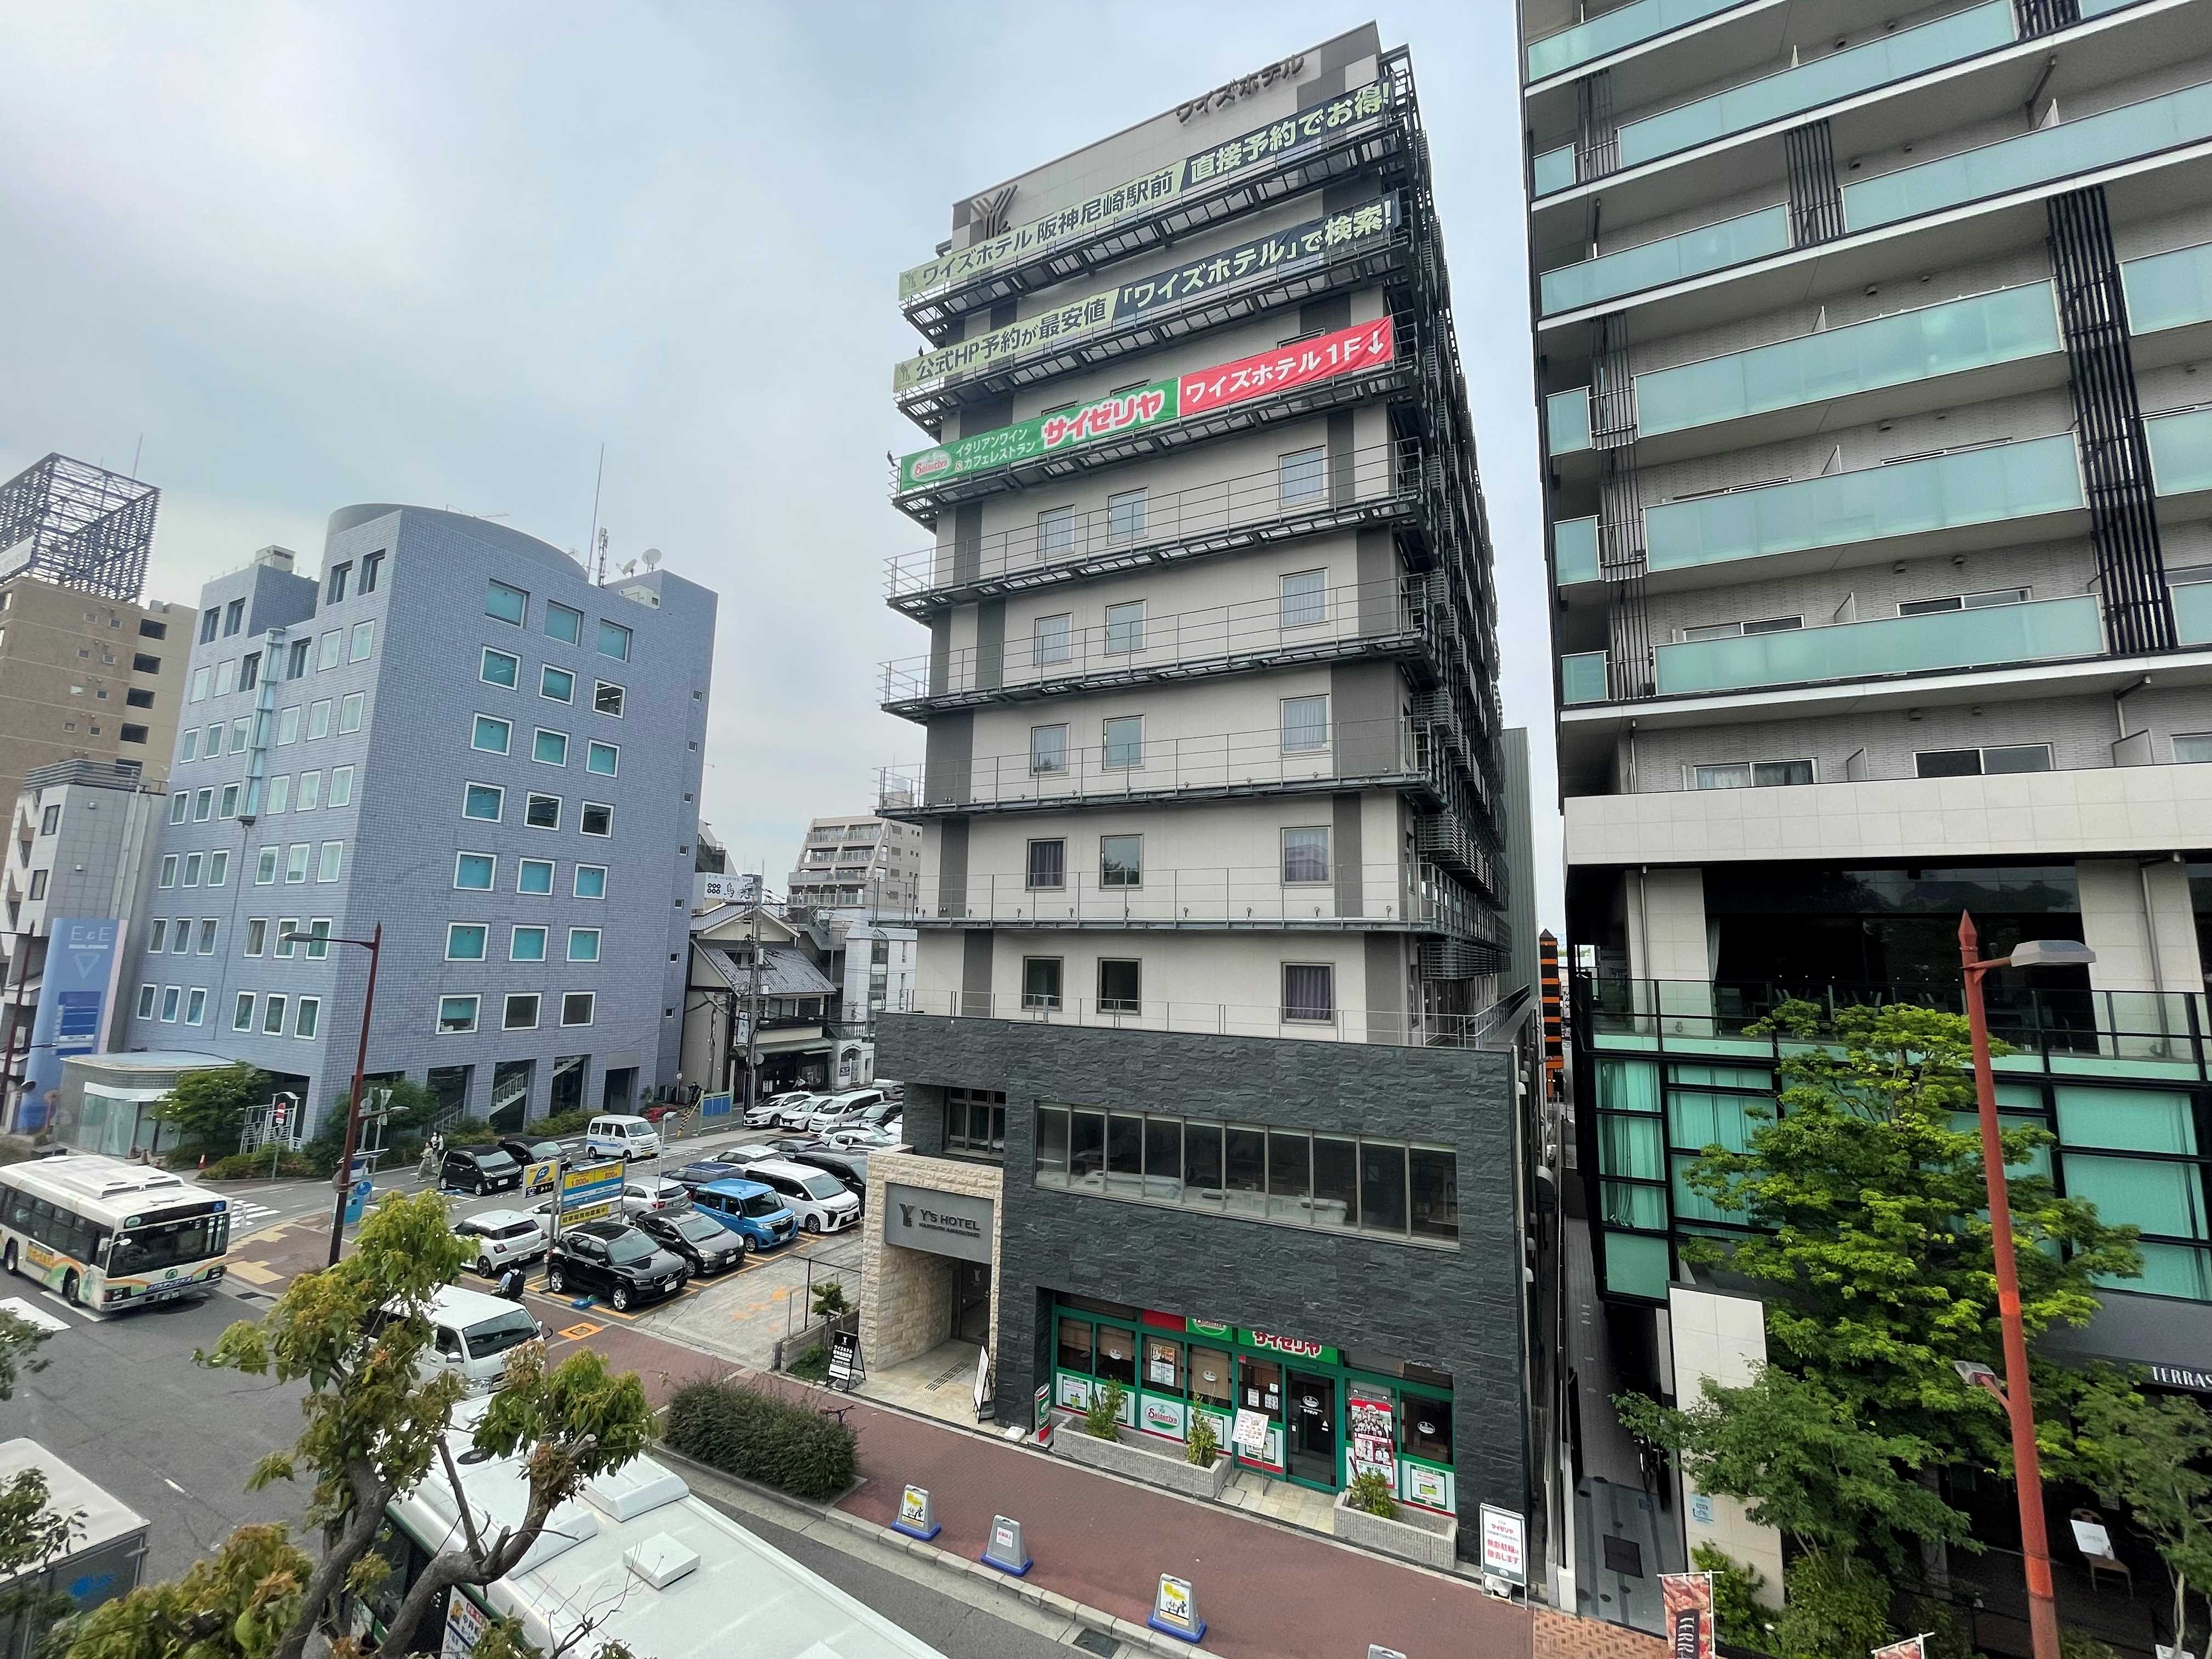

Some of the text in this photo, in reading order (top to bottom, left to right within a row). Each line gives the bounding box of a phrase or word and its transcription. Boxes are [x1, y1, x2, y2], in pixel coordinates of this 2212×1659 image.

[1176, 54, 1305, 124] ワイズホテル
[923, 82, 1389, 286] ワイズホテル 阪神尼崎駅前 直接予約でお得!
[916, 300, 1105, 381] 公式HP予約が最安値
[1044, 336, 1361, 446] サイゼリヤ ワイズホテル 1F
[956, 428, 1027, 457] イタリアンワイン
[940, 1214, 980, 1231] HOTEL
[1254, 1331, 1322, 1357] サイゼリヤ
